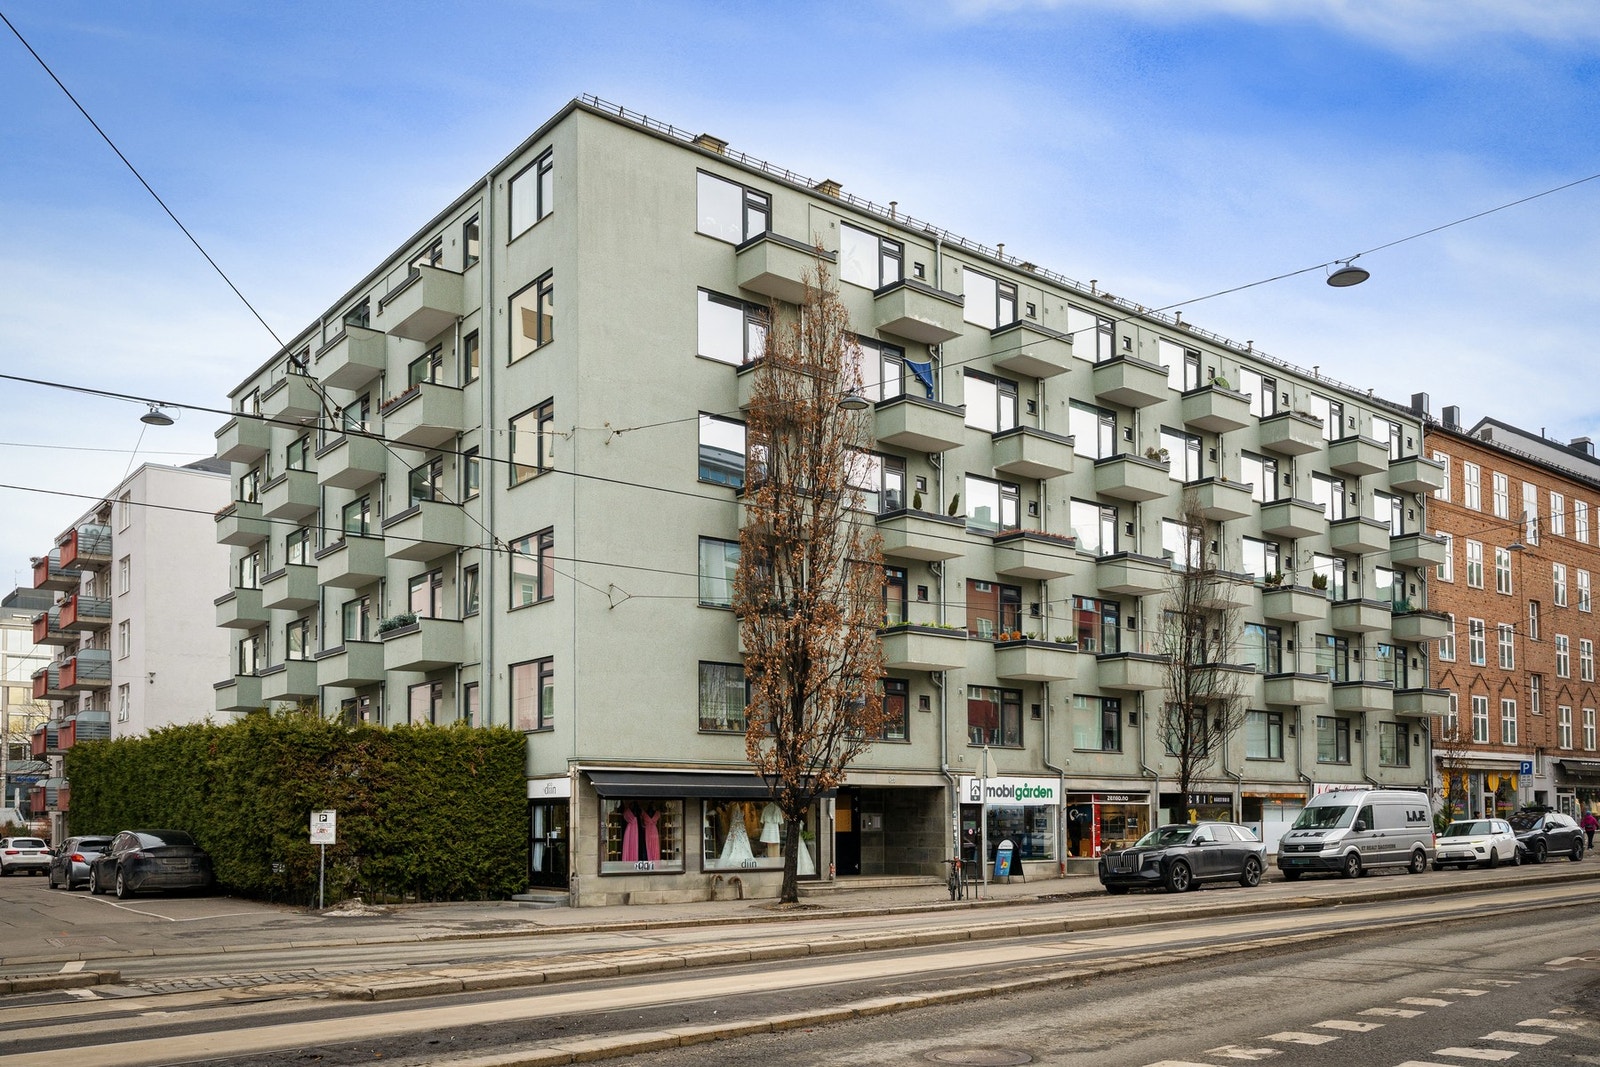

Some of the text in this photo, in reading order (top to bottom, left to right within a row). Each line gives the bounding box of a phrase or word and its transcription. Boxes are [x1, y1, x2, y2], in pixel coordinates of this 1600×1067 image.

[1523, 762, 1530, 773] P
[986, 783, 1053, 801] mobilgården
[1406, 810, 1426, 822] LAJE
